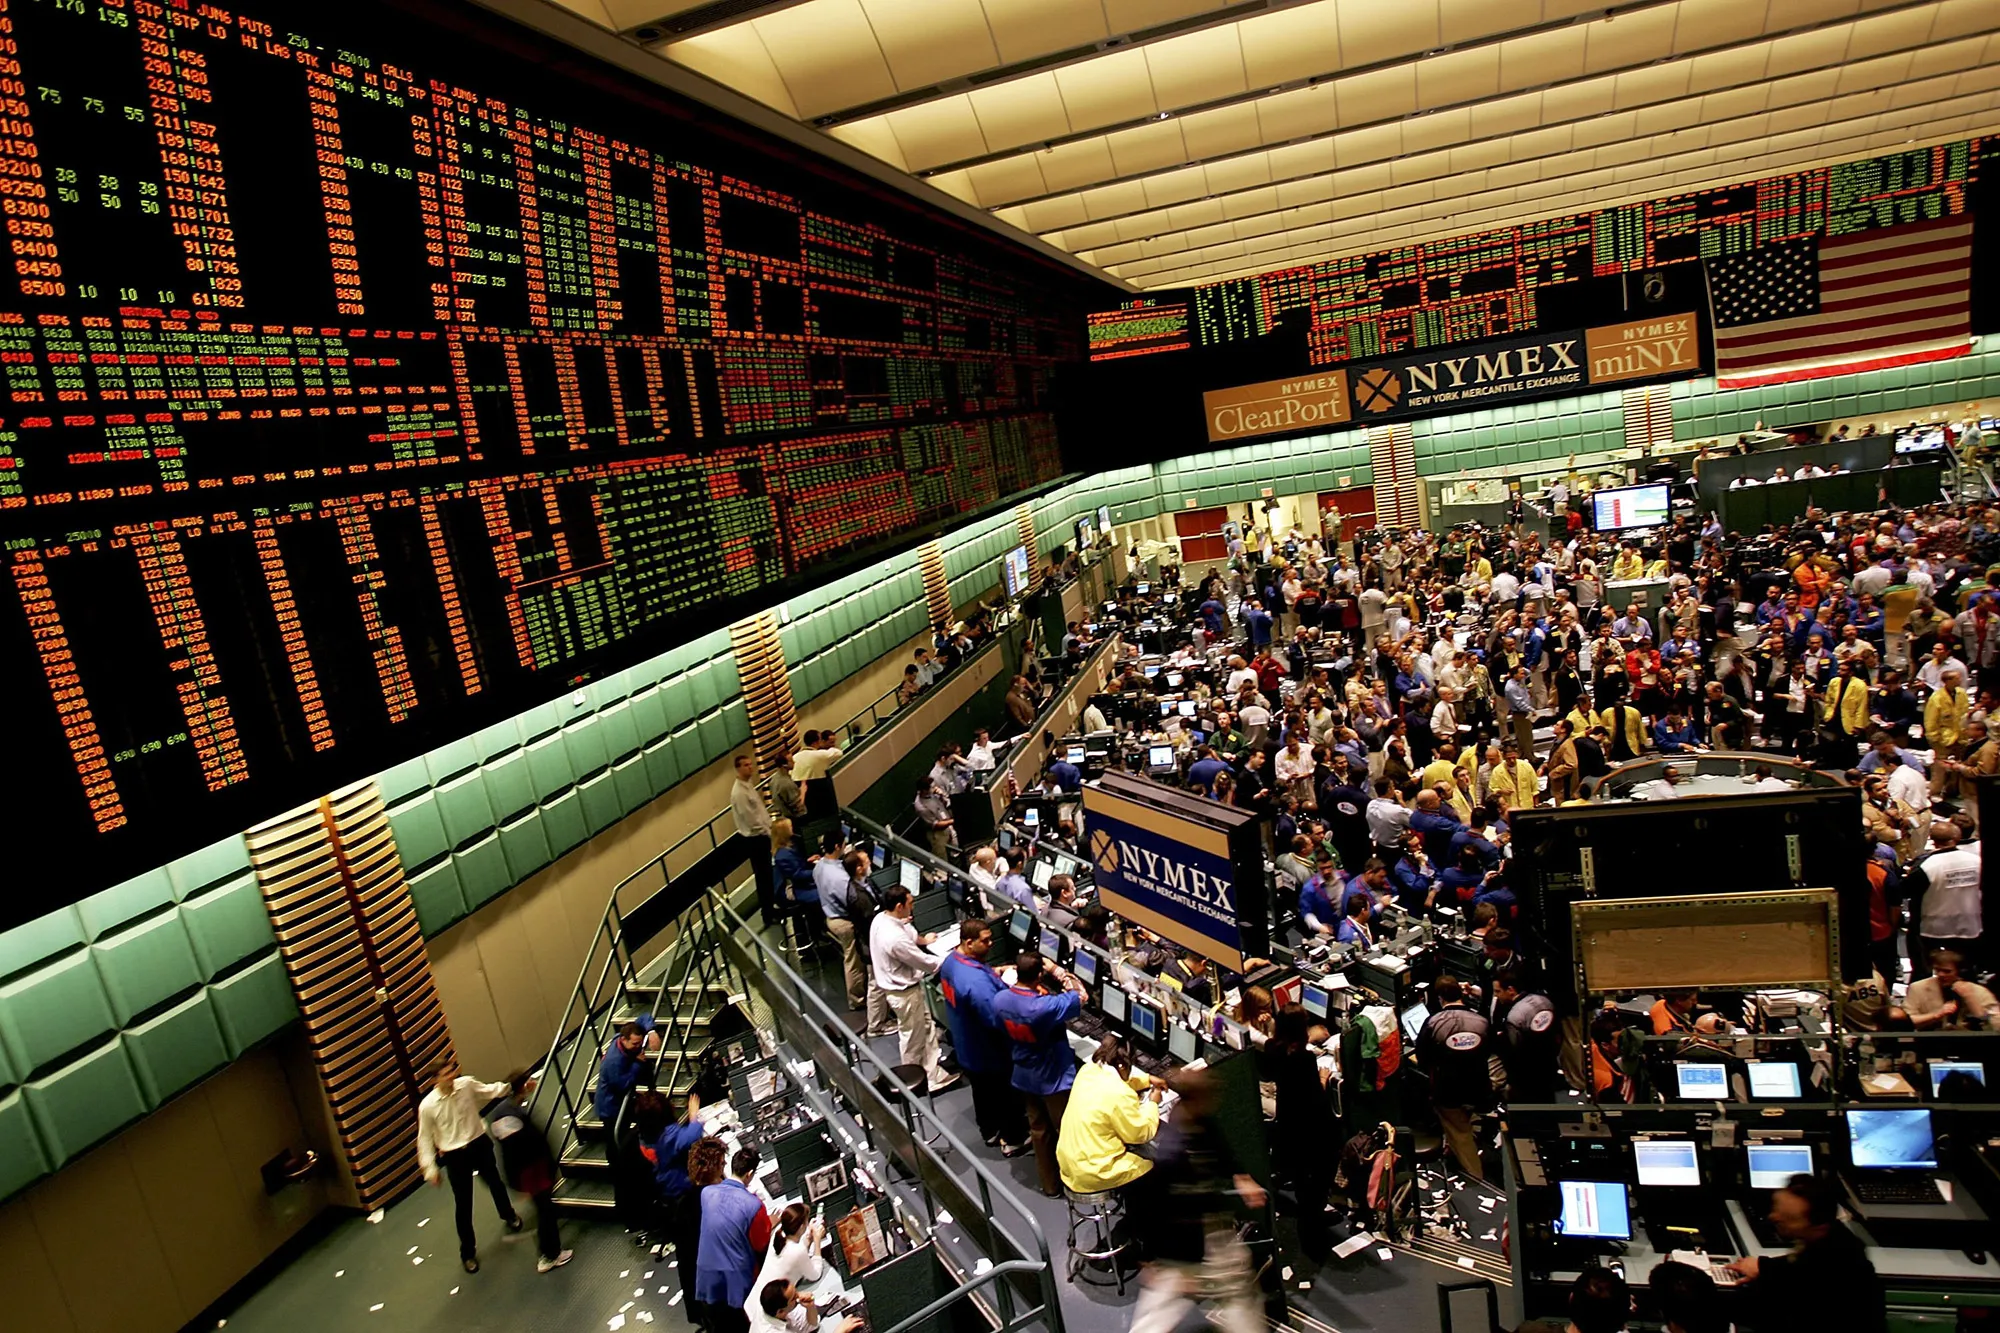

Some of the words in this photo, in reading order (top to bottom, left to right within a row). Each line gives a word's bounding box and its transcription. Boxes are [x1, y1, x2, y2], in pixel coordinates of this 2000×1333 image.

[99, 8, 128, 27] 155
[138, 19, 167, 39] 352
[142, 38, 169, 57] 320
[179, 50, 206, 67] 456
[197, 4, 232, 24] JUN6
[238, 16, 272, 37] PUTS
[288, 33, 309, 49] 250
[335, 52, 369, 71] 25000
[382, 64, 413, 82] CALLS
[172, 12, 199, 30] STP
[208, 23, 226, 39] LO
[241, 34, 258, 49] HI
[266, 41, 290, 58] LAS
[296, 51, 319, 67] STK
[332, 62, 353, 78] LAS
[365, 73, 378, 86] HI
[384, 79, 397, 91] LO
[408, 86, 426, 99] STP
[144, 56, 172, 75] 290
[181, 68, 208, 85] 480
[147, 76, 176, 94] 262
[184, 85, 212, 103] 505
[306, 69, 334, 87] 7950
[335, 78, 354, 93] 540
[361, 86, 379, 100] 540
[386, 94, 403, 107] 540
[308, 86, 336, 103] 8000
[38, 87, 60, 103] 75
[83, 97, 104, 113] 75
[124, 107, 144, 122] 55
[150, 94, 179, 112] 235
[311, 102, 338, 118] 8050
[153, 113, 181, 130] 211
[190, 121, 216, 137] 557
[312, 118, 340, 134] 8100
[411, 115, 429, 129] 671
[157, 132, 185, 148] 189
[193, 139, 220, 155] 584
[315, 134, 342, 149] 8150
[413, 130, 431, 143] 645
[160, 150, 189, 166] 168
[196, 157, 223, 172] 613
[317, 149, 344, 165] 8200
[344, 154, 364, 169] 430
[371, 163, 388, 174] 430
[395, 168, 412, 179] 430
[414, 144, 432, 156] 620
[56, 168, 76, 183] 38
[99, 175, 118, 190] 38
[139, 182, 158, 196] 38
[164, 168, 190, 184] 150
[198, 174, 226, 190] 642
[319, 165, 346, 180] 8250
[417, 172, 436, 185] 573
[321, 181, 348, 195] 8300
[58, 188, 79, 202] 50
[101, 194, 121, 208] 50
[141, 200, 159, 214] 50
[166, 186, 194, 201] 133
[202, 192, 227, 207] 671
[323, 196, 350, 211] 8350
[3, 198, 50, 218] 8300
[170, 204, 197, 219] 118
[204, 209, 230, 224] 701
[325, 212, 352, 226] 8400
[7, 219, 53, 238] 8350
[173, 222, 200, 237] 104
[207, 226, 234, 241] 732
[328, 227, 355, 241] 8450
[11, 240, 58, 257] 8400
[183, 240, 202, 254] 91
[210, 244, 236, 257] 764
[329, 243, 356, 256] 8500
[15, 260, 61, 277] 8450
[186, 258, 204, 271] 80
[213, 260, 239, 274] 796
[332, 258, 359, 271] 8550
[216, 278, 241, 291] 829
[334, 273, 361, 285] 8600
[20, 280, 65, 296] 8500
[79, 285, 97, 298] 10
[120, 288, 138, 301] 10
[158, 291, 175, 303] 10
[192, 293, 210, 305] 61
[218, 294, 244, 307] 862
[336, 288, 362, 300] 8650
[338, 303, 364, 315] 8700
[1623, 320, 1689, 340] NYMEX
[1405, 339, 1580, 394] NYMEX
[1594, 338, 1689, 378] miNY
[1281, 376, 1339, 395] NYMEX
[1408, 397, 1431, 406] NEW
[1432, 392, 1460, 403] YORK
[1461, 382, 1524, 399] MERCANTILE
[1526, 372, 1580, 389] EXCHANGE
[168, 402, 182, 410] NO
[187, 401, 222, 409] LIMITS
[1214, 398, 1341, 434] ClearPort
[1119, 840, 1235, 912] NYMEX
[1123, 871, 1139, 884] NEW
[1139, 877, 1155, 892] YORK
[1156, 886, 1197, 909] MERCANTILE
[1198, 901, 1236, 927] EXCHANGE
